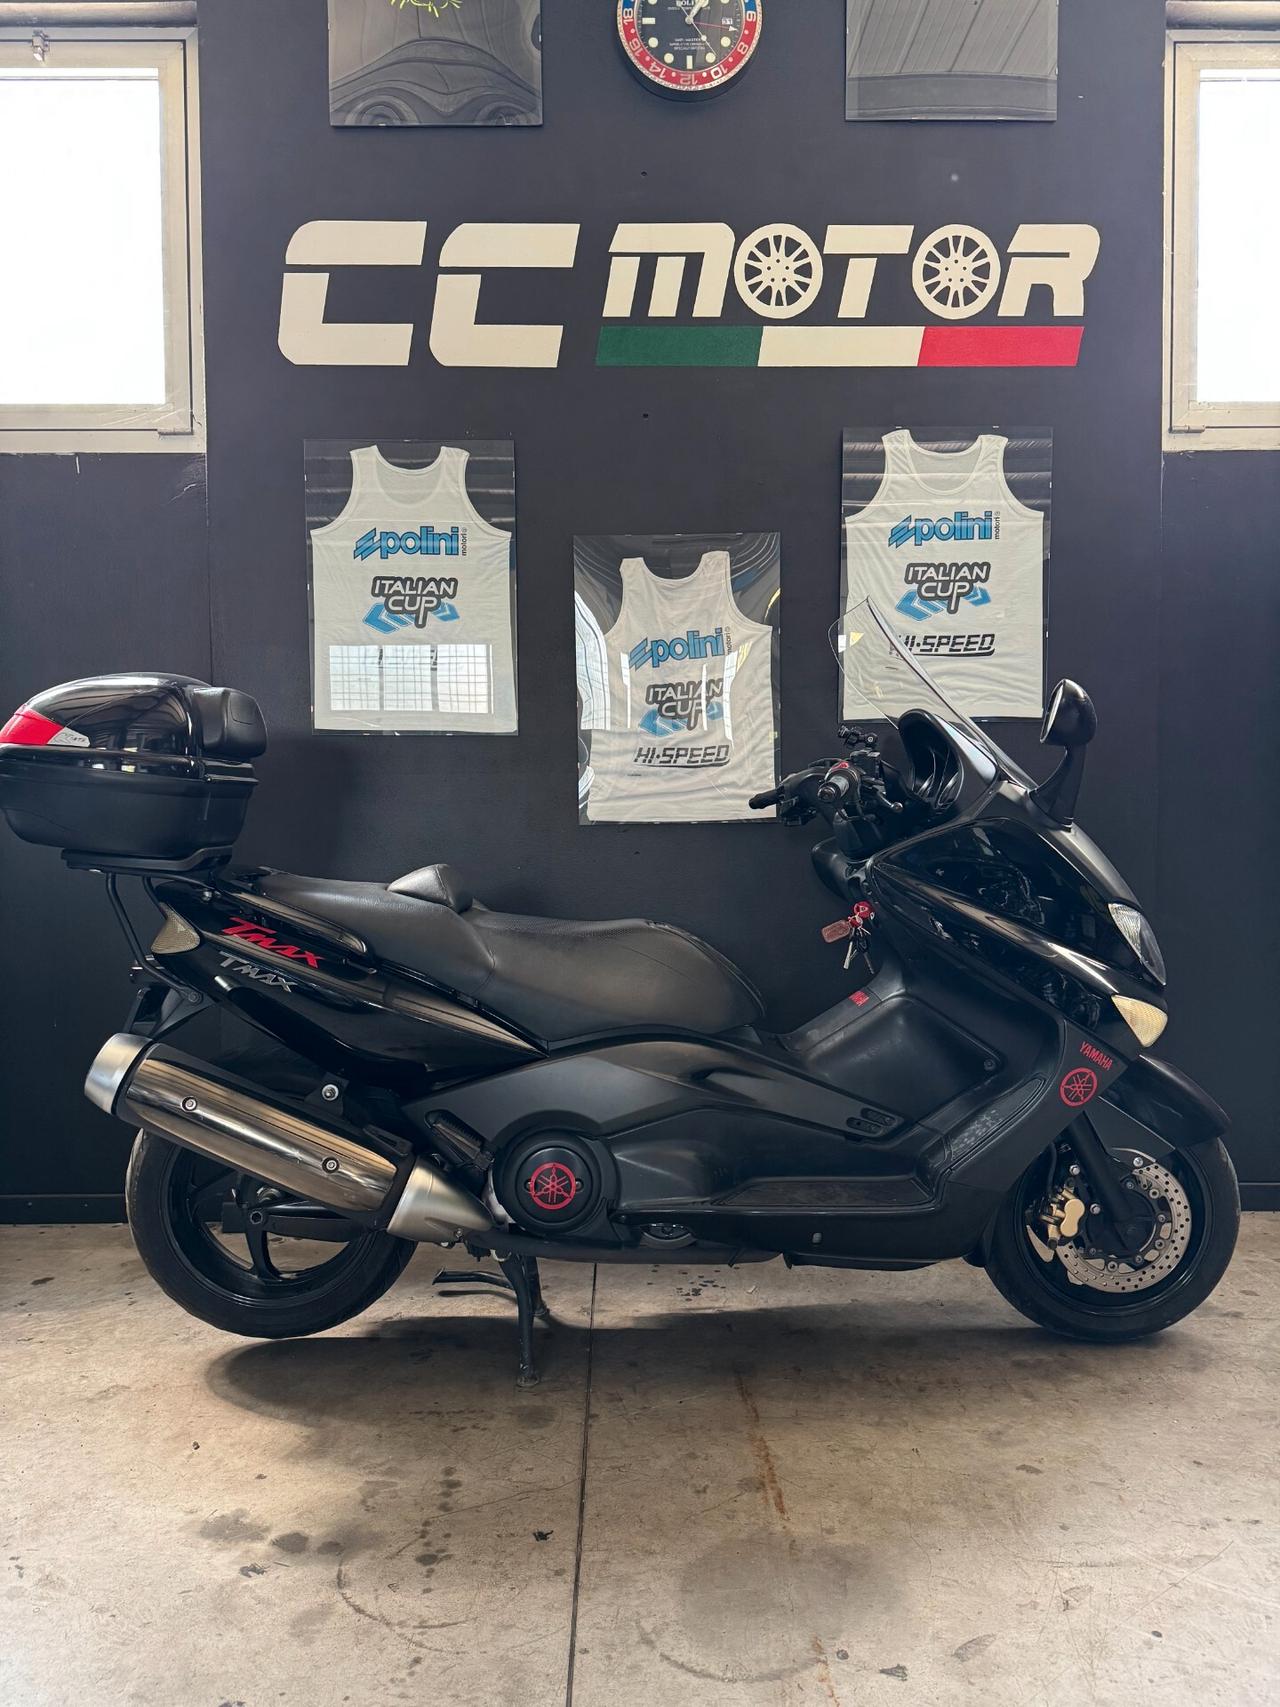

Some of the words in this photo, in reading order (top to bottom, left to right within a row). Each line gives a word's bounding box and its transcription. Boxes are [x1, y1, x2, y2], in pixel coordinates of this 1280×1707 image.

[649, 61, 667, 79] 14
[710, 64, 728, 80] 10
[277, 220, 580, 367] CC
[602, 223, 1101, 320] MOTOR
[379, 525, 460, 560] polini
[913, 510, 993, 547] polini
[372, 577, 457, 597] ITALIAN
[906, 563, 990, 582] ITALIAN
[386, 594, 440, 627] CUP
[918, 580, 972, 613] CUP
[650, 627, 725, 668] polini
[1080, 1041, 1113, 1071] YAMAHA
